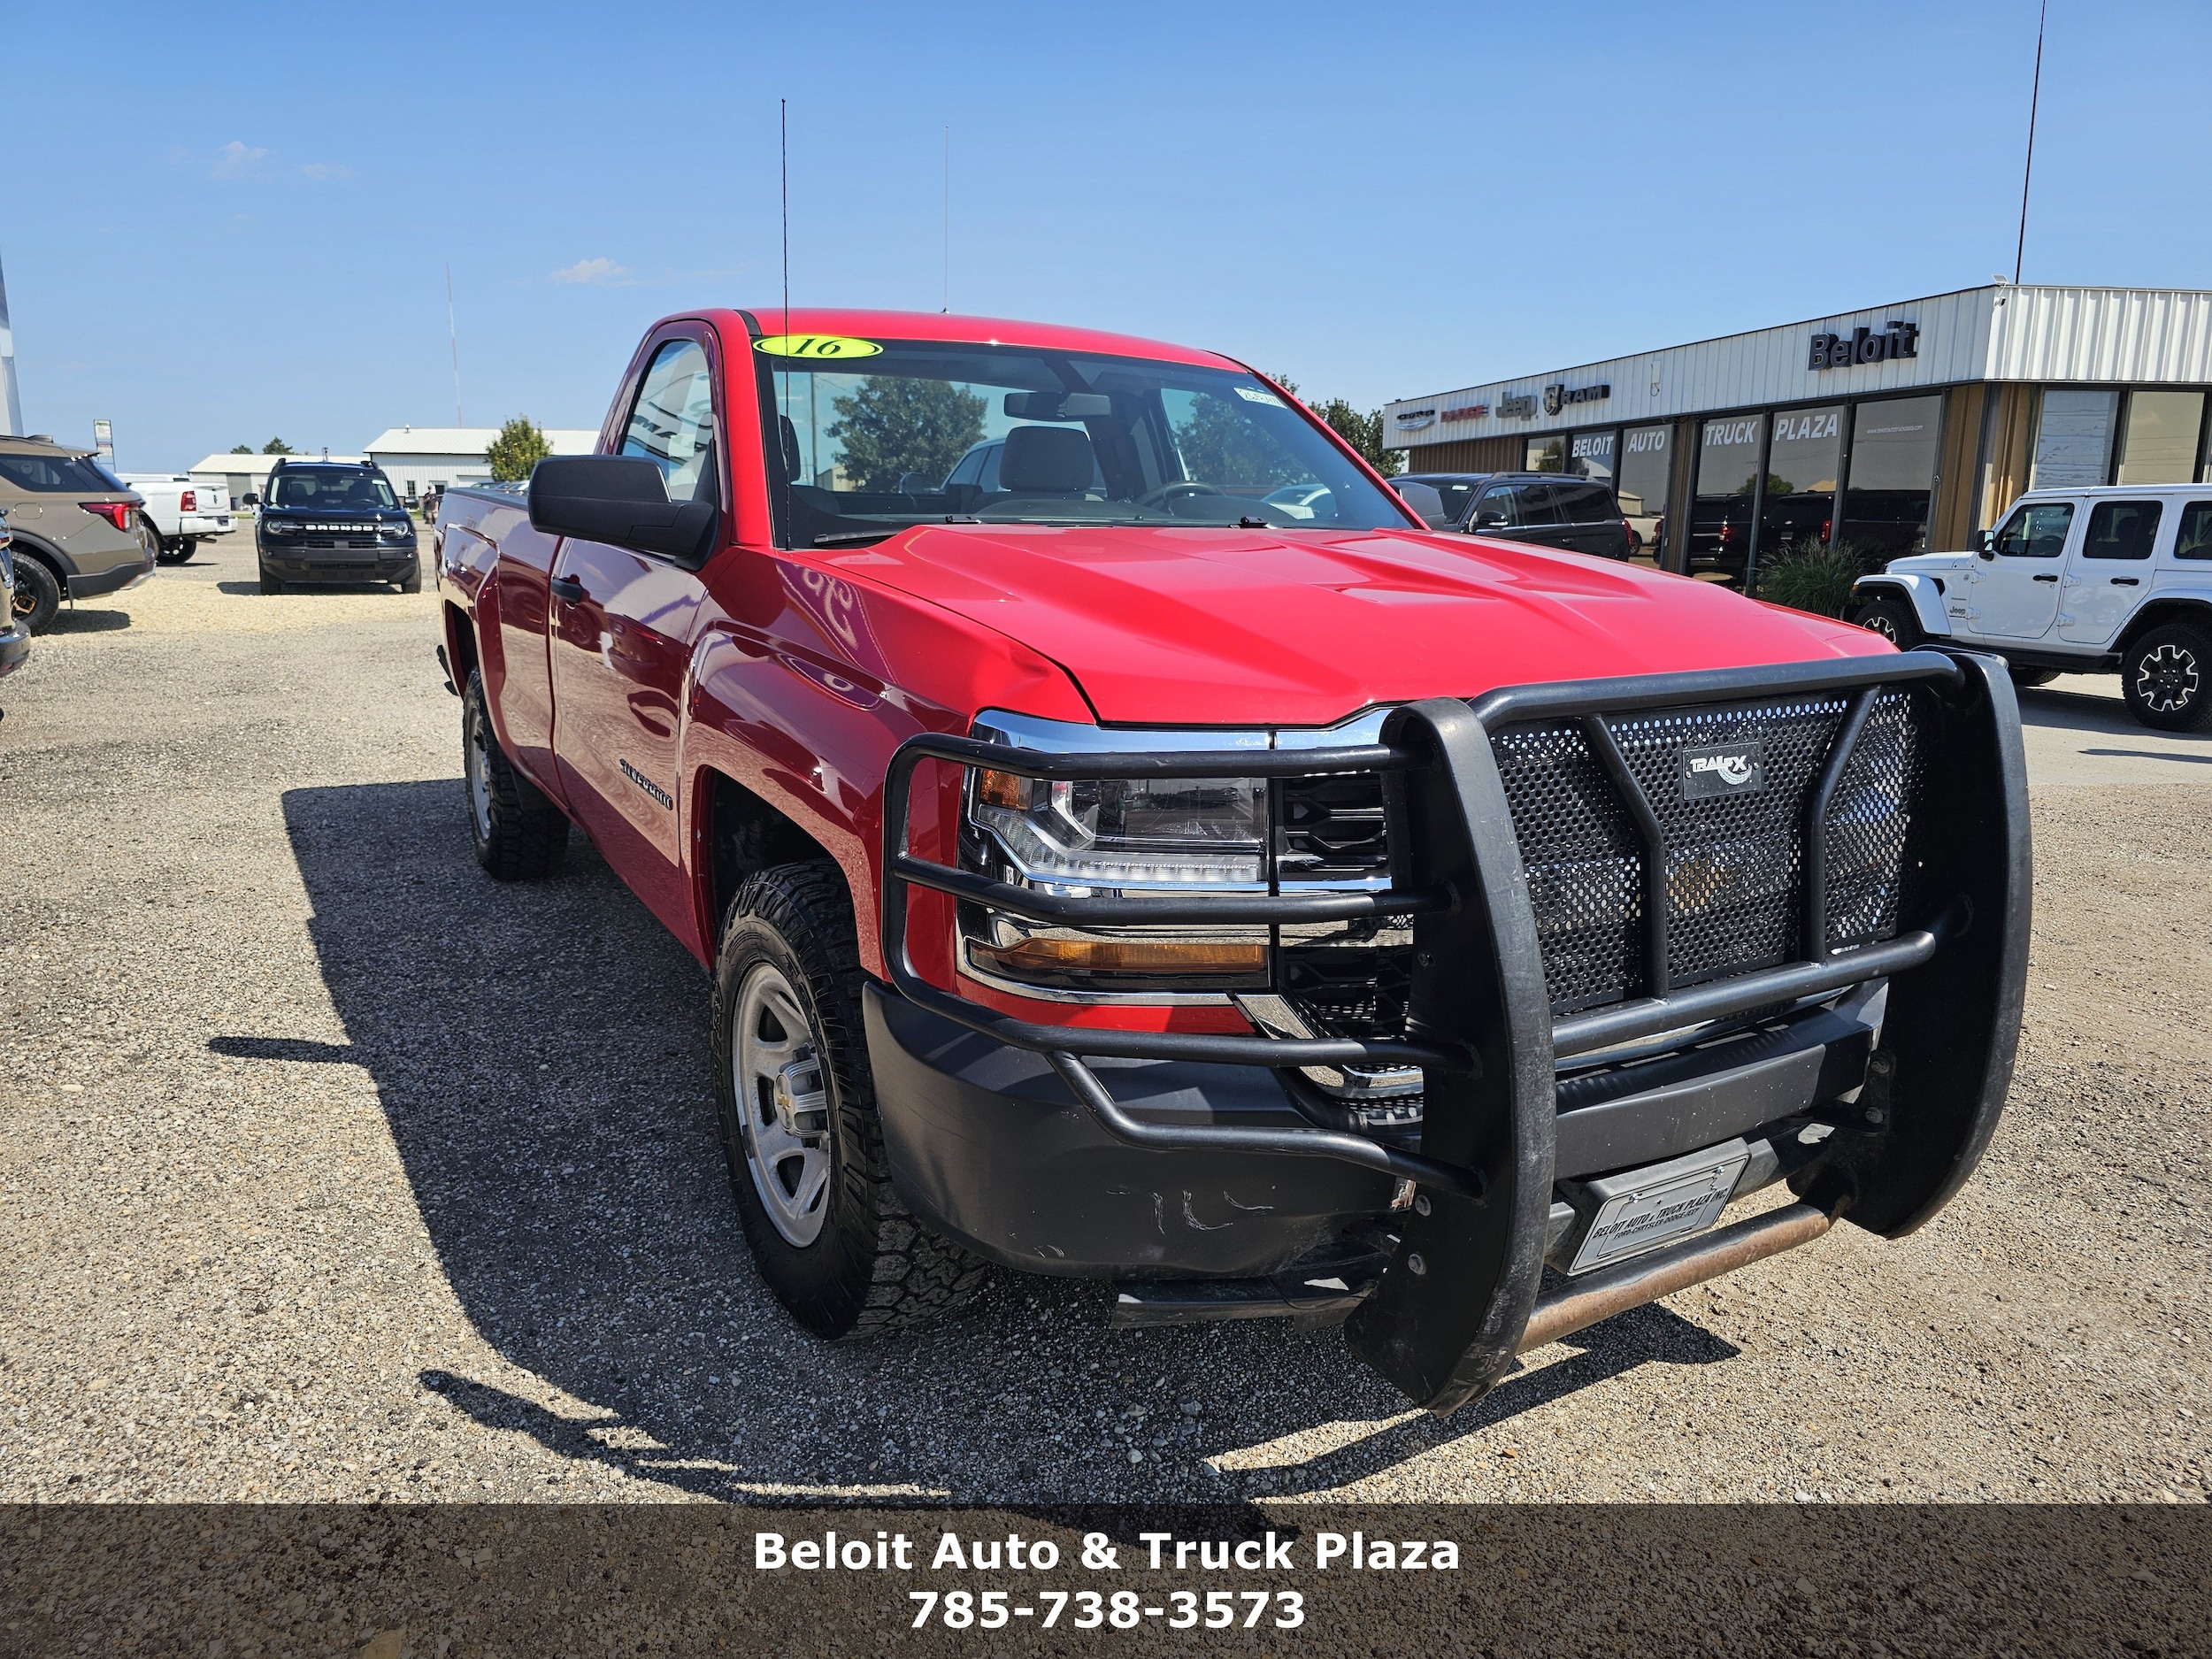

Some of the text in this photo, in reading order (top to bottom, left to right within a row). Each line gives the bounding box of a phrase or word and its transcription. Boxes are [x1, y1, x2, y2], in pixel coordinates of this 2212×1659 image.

[790, 338, 847, 356] 16
[1809, 320, 1919, 371] Beloit
[1495, 392, 1538, 421] Jeep
[1560, 385, 1610, 406] RAM
[1440, 404, 1489, 423] DODGE
[1571, 413, 1838, 457] BELOIT AUTO TRUCK PLAZA
[1594, 1220, 1626, 1239] BELOIT
[1626, 1212, 1650, 1229] AUTO
[1656, 1202, 1686, 1218] TRUCK
[1684, 1194, 1709, 1211] PLAZA
